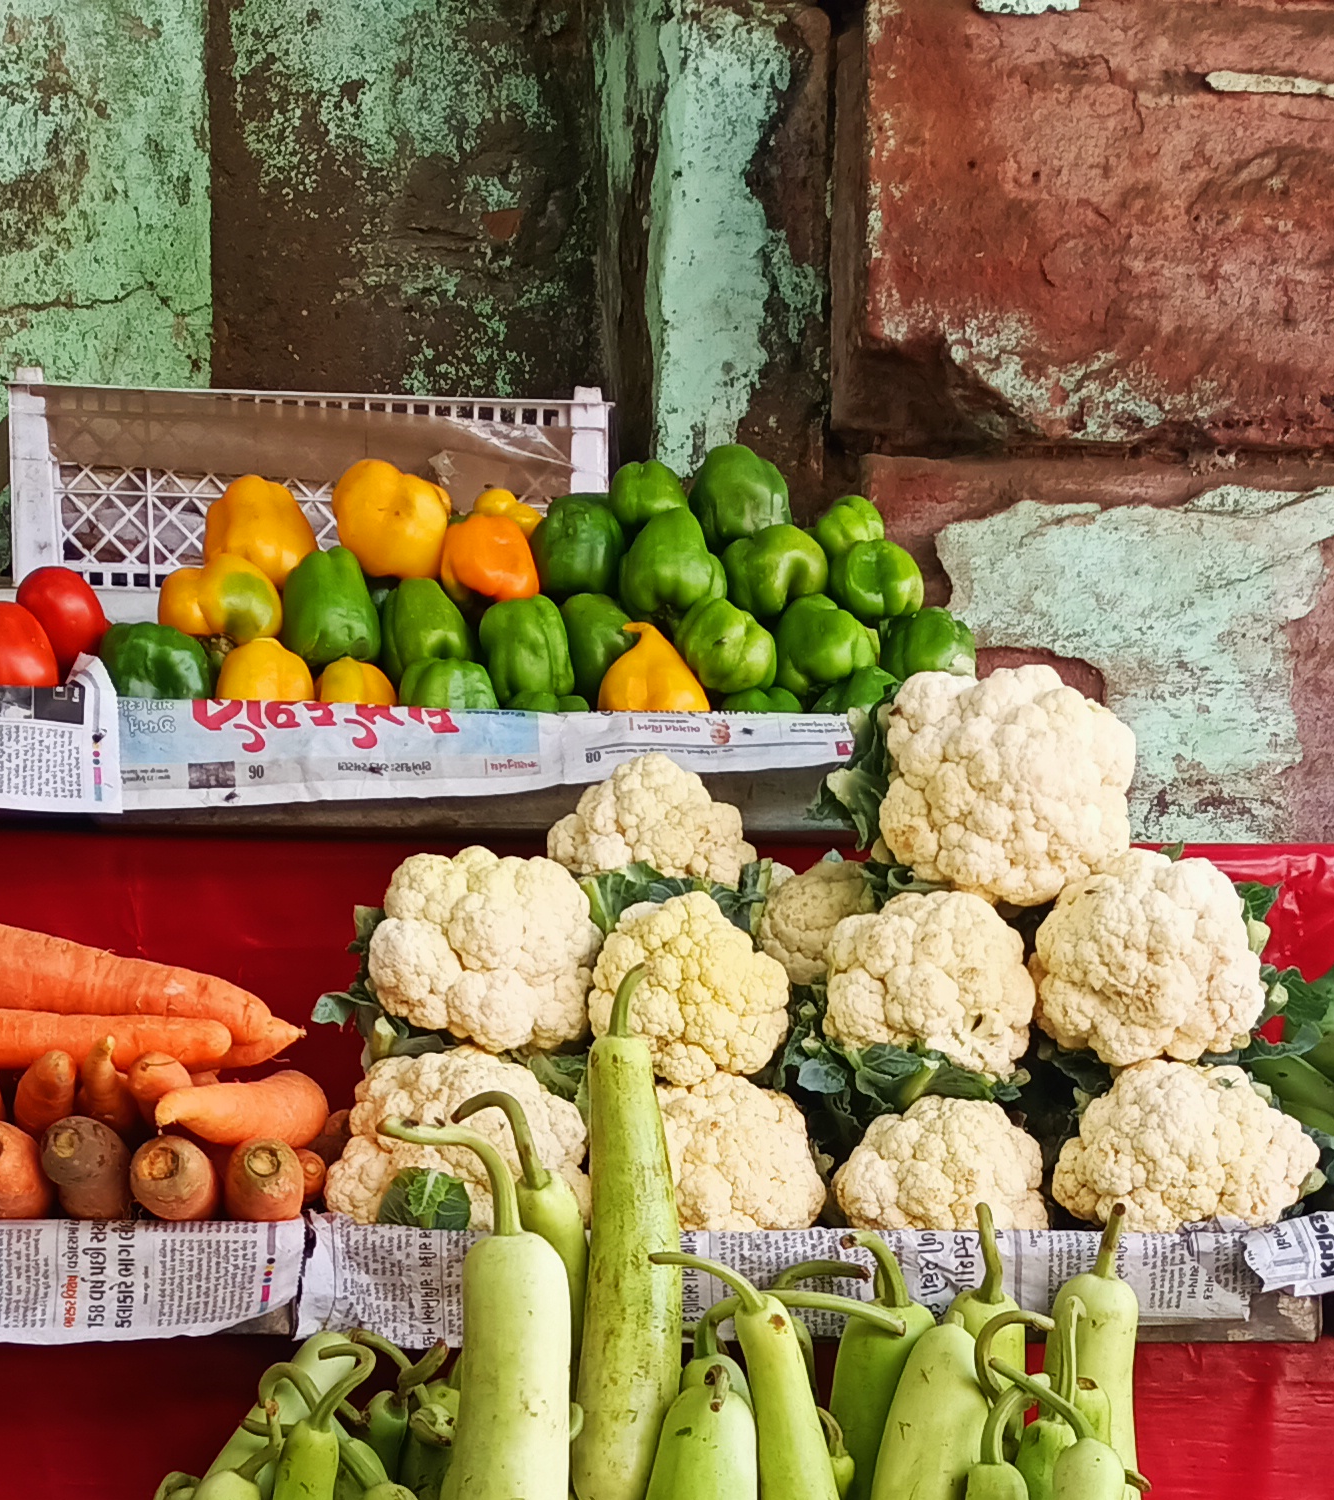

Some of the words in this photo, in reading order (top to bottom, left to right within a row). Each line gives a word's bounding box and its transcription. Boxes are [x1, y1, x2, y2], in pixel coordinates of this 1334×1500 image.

[82, 1247, 106, 1276] પછી
[117, 1244, 135, 1277] ભાગ
[80, 1277, 106, 1301] વર્ષ
[87, 1305, 105, 1328] 158
[109, 1281, 134, 1328] કલાકારે
